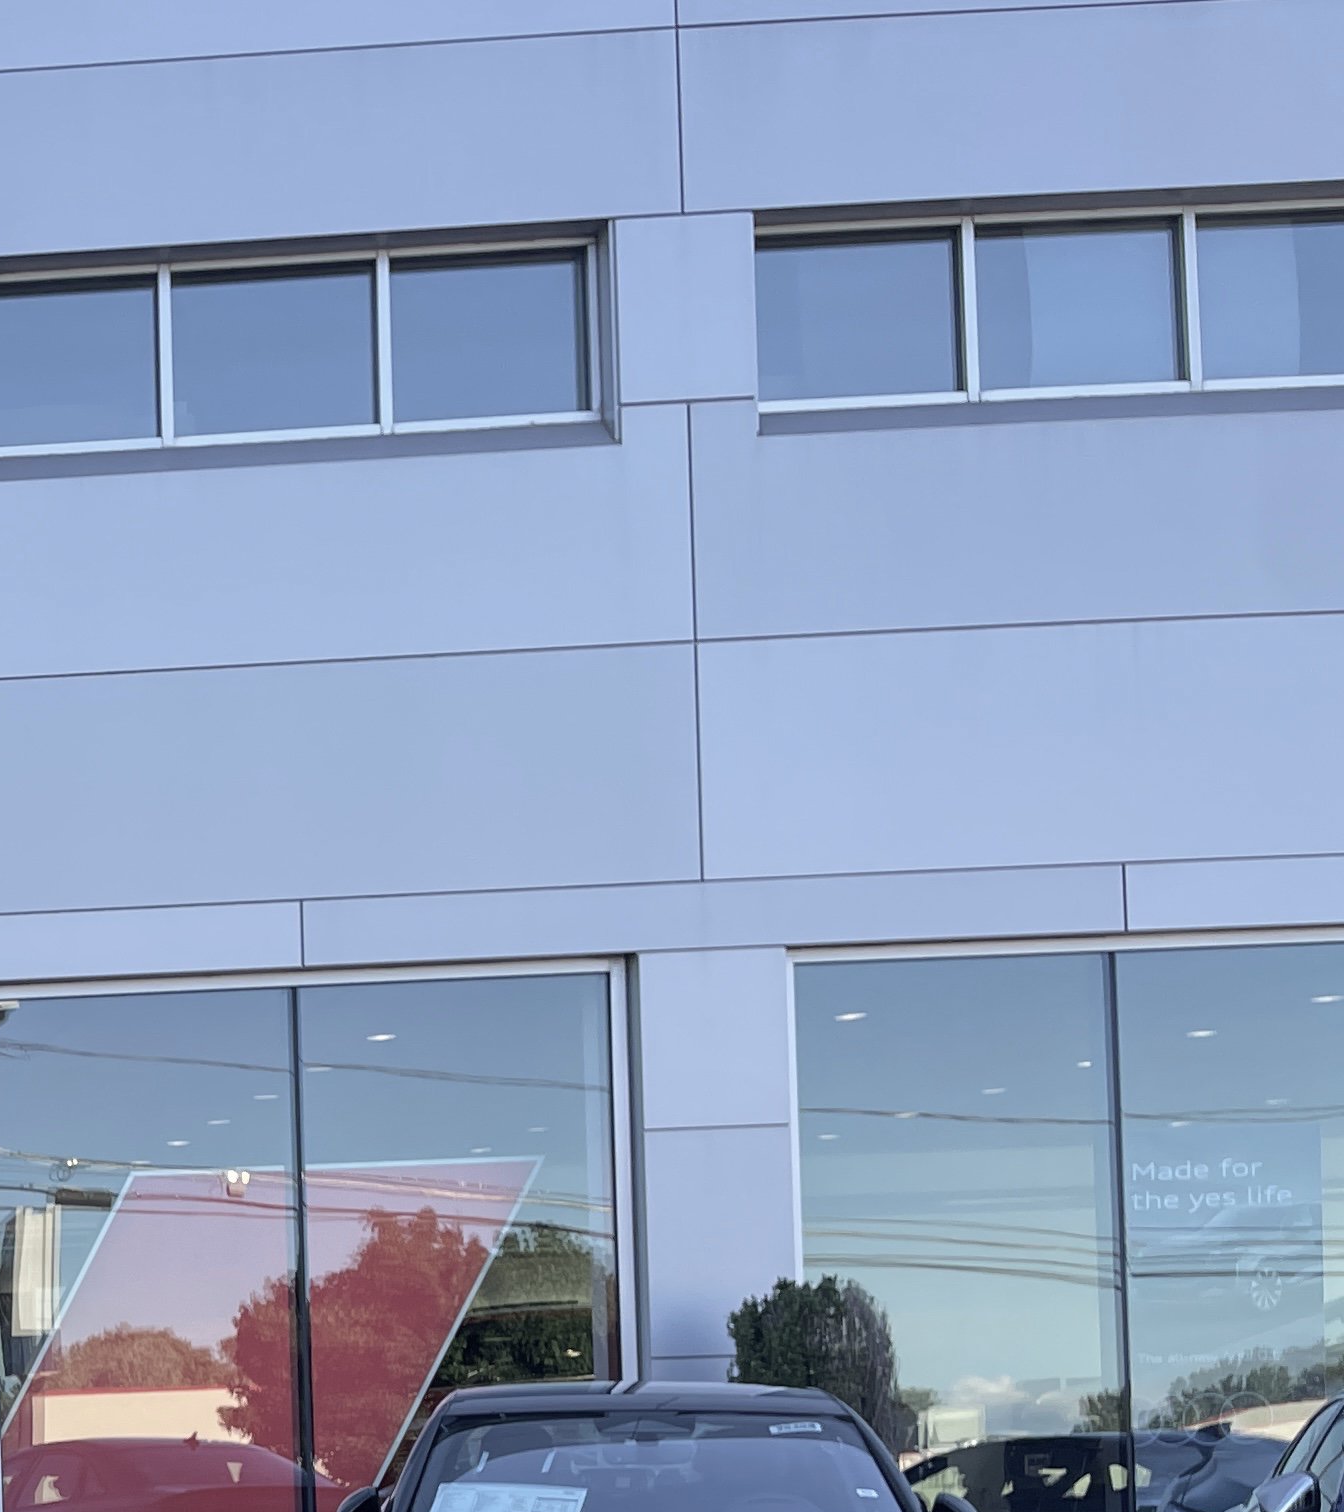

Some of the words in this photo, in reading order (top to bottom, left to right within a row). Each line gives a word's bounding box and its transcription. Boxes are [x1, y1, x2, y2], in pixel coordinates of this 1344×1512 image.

[1131, 1160, 1209, 1181] Made
[1219, 1157, 1263, 1178] for
[1130, 1191, 1179, 1211] the
[1189, 1190, 1236, 1214] yes
[1247, 1184, 1293, 1207] life
